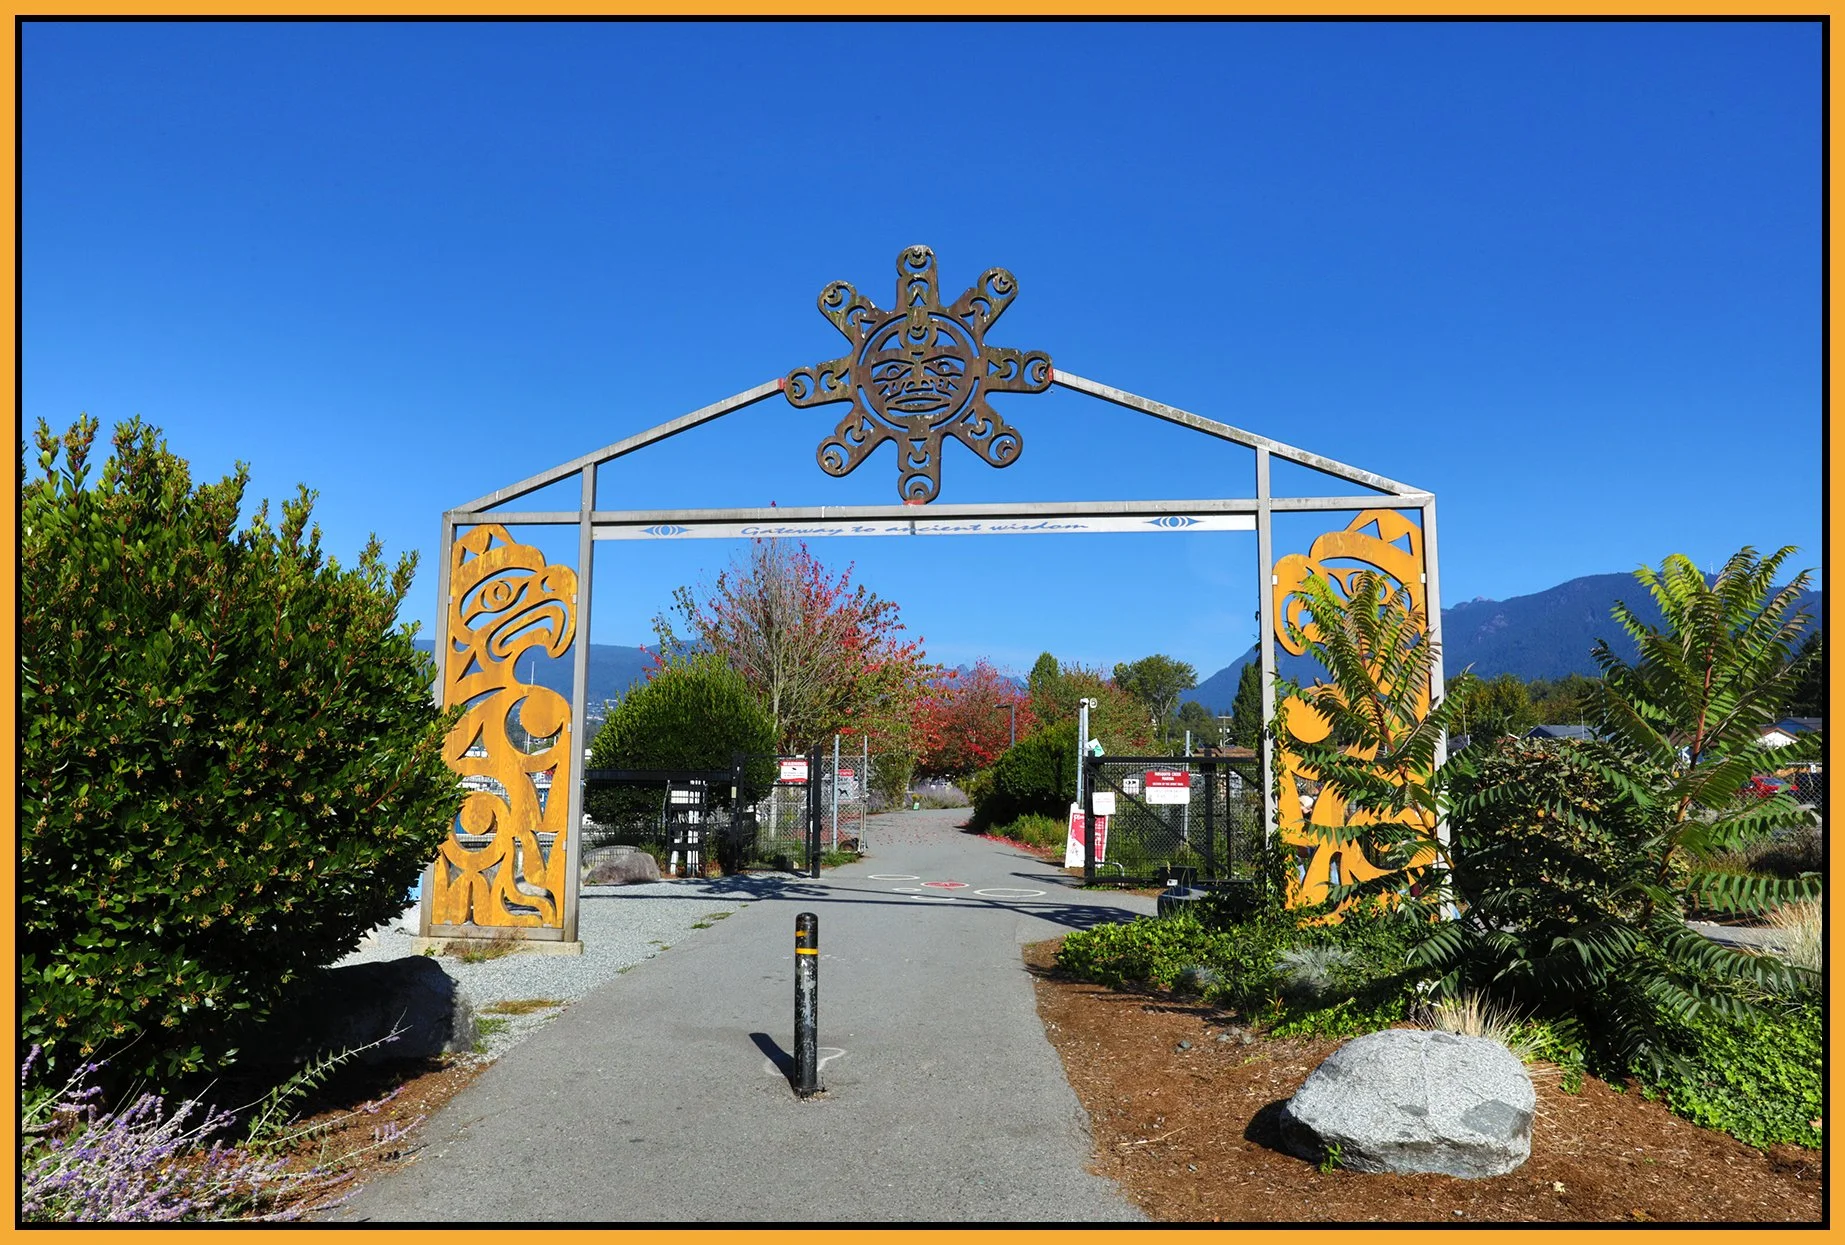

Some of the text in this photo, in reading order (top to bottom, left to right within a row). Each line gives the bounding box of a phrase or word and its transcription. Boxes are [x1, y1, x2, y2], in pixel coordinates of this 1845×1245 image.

[741, 526, 844, 535] Gateway
[885, 524, 981, 532] ancient
[989, 521, 1089, 530] wisdom
